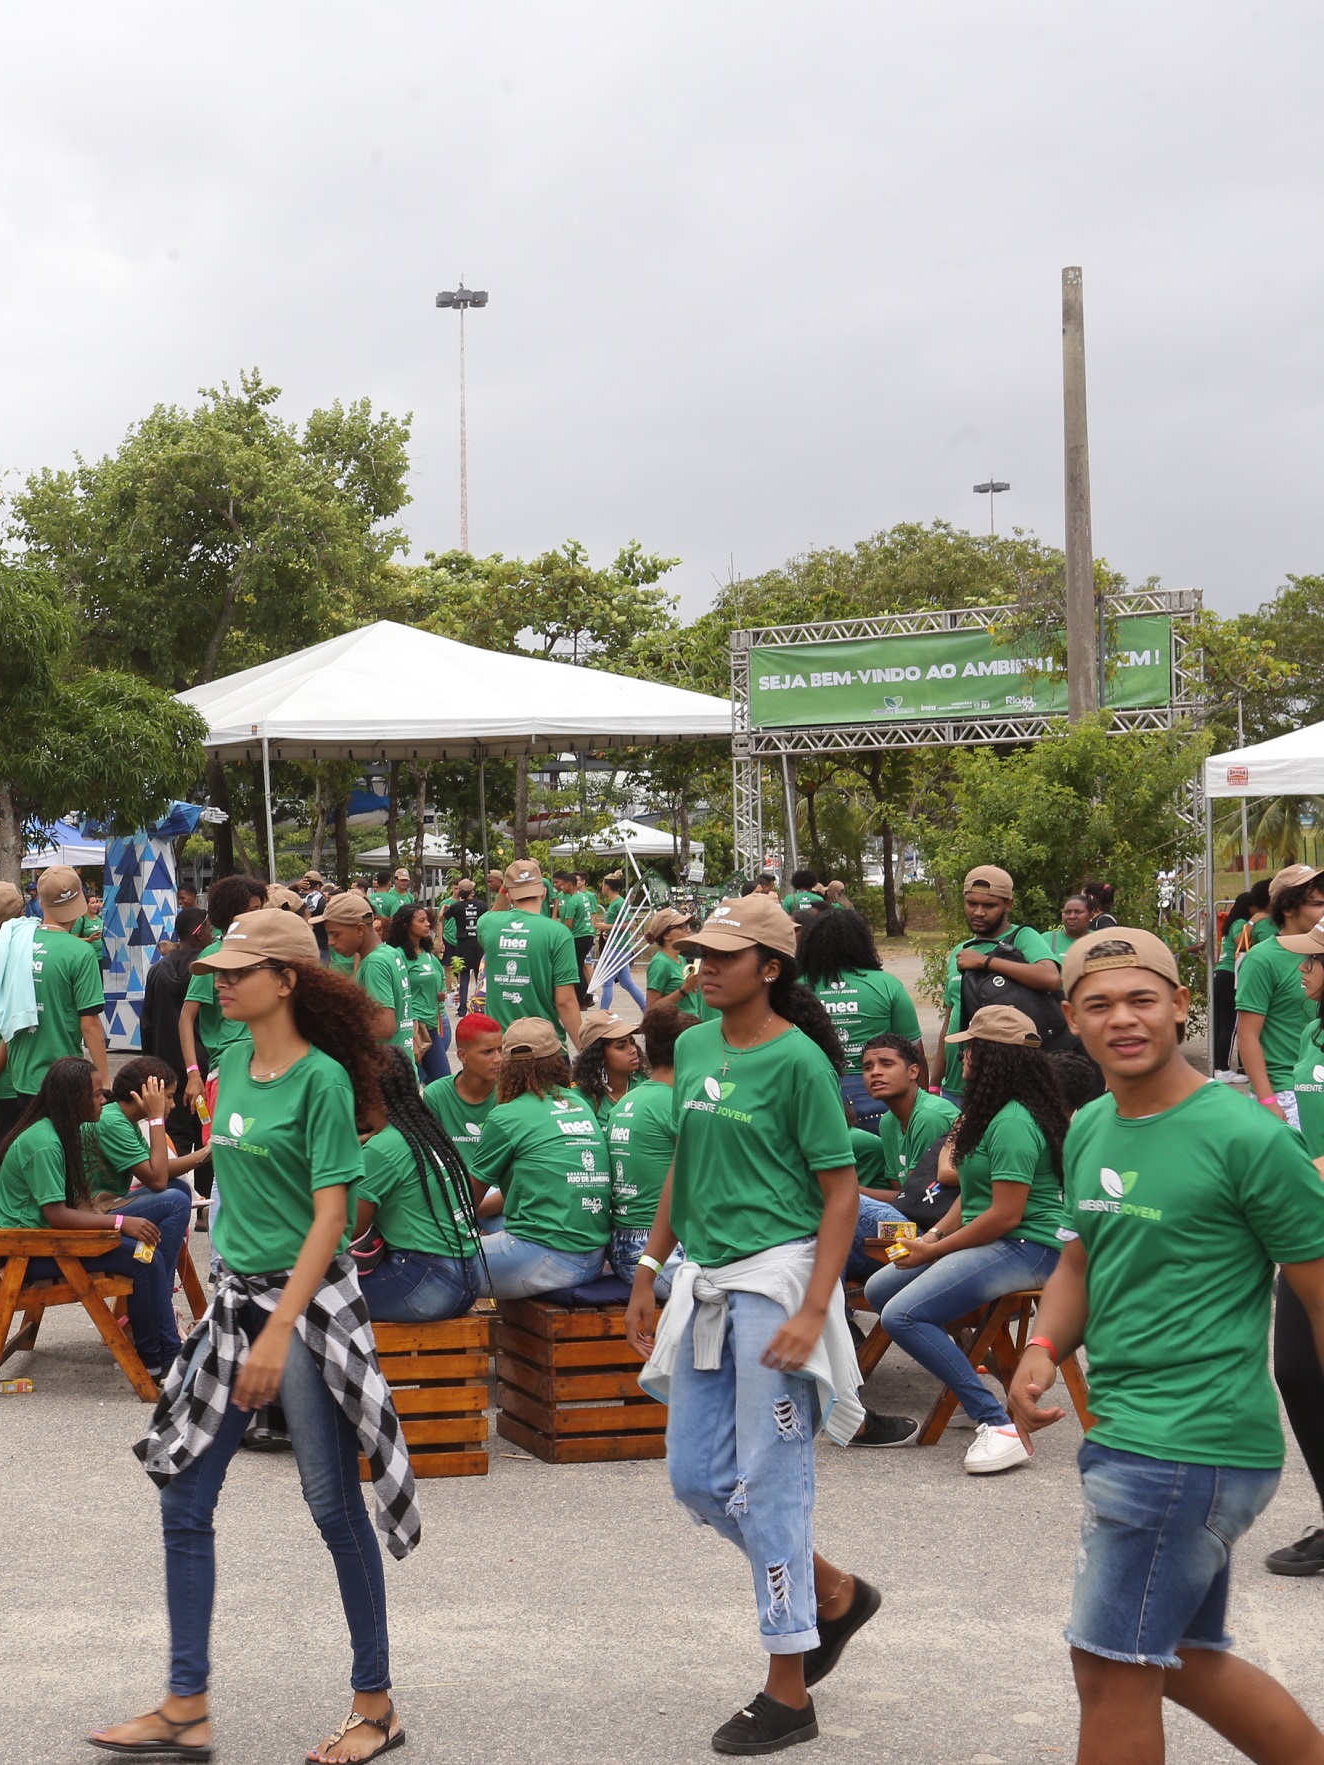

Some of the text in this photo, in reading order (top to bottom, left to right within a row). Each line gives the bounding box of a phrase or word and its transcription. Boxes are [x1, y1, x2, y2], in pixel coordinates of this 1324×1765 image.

[758, 674, 807, 691] SEJA
[810, 666, 922, 688] BEM-VINDO
[926, 663, 957, 680] AO
[961, 656, 1067, 678] AMBIENT
[499, 935, 528, 948] inea
[1293, 1083, 1323, 1093] AMBIENTE
[716, 1105, 753, 1124] JOVEM
[556, 1119, 595, 1134] inea
[610, 1123, 631, 1142] inea
[451, 1135, 481, 1143] AMBIENTE
